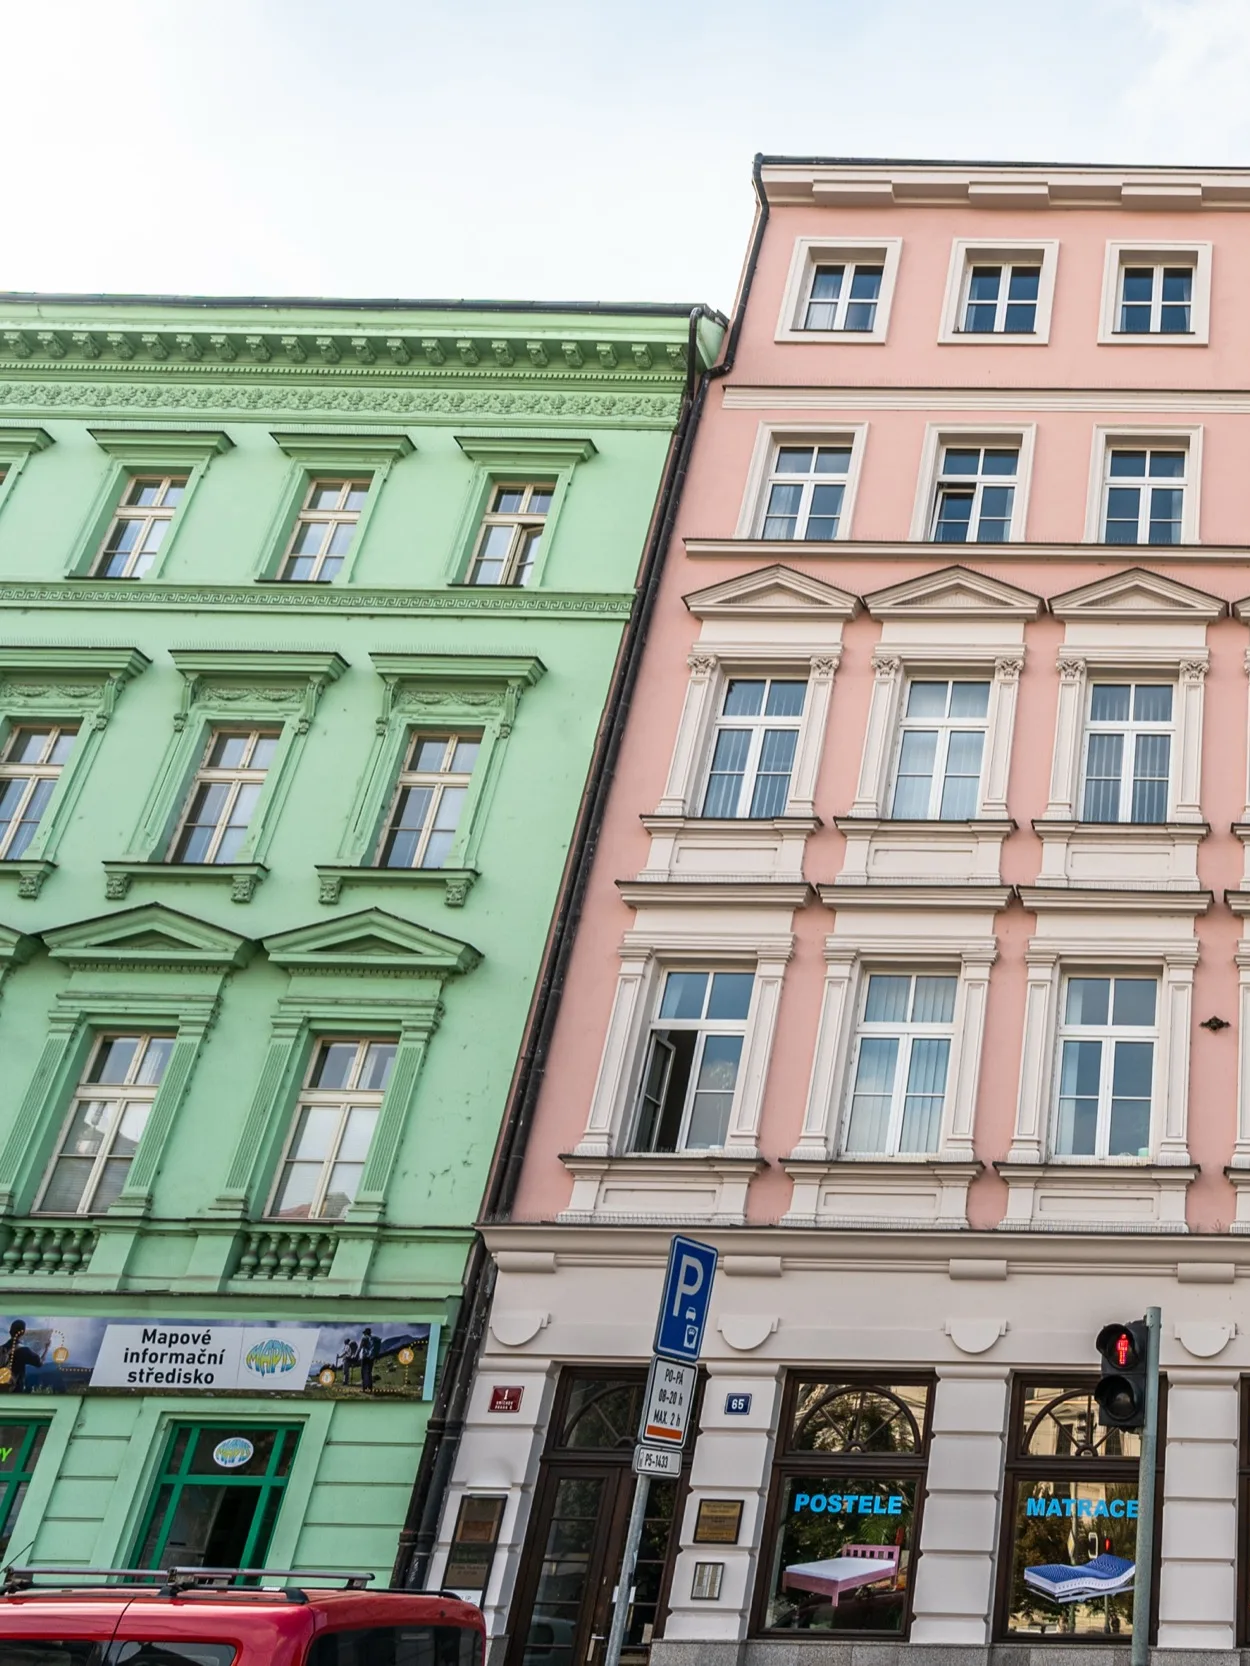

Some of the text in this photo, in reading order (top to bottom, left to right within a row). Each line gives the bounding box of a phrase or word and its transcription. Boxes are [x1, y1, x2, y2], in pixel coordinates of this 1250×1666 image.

[673, 1254, 704, 1317] P
[141, 1328, 212, 1348] Mapové
[123, 1348, 226, 1365] informační
[245, 1339, 297, 1378] MAPIS
[127, 1368, 215, 1385] středisko
[664, 1368, 684, 1386] PO-PÁ
[504, 1389, 509, 1400] 1
[658, 1388, 683, 1406] 08-20 h
[731, 1398, 745, 1411] 65
[653, 1409, 681, 1427] MAX. 2 h
[794, 1493, 903, 1515] POSTELE
[1026, 1497, 1139, 1518] MATRACE
